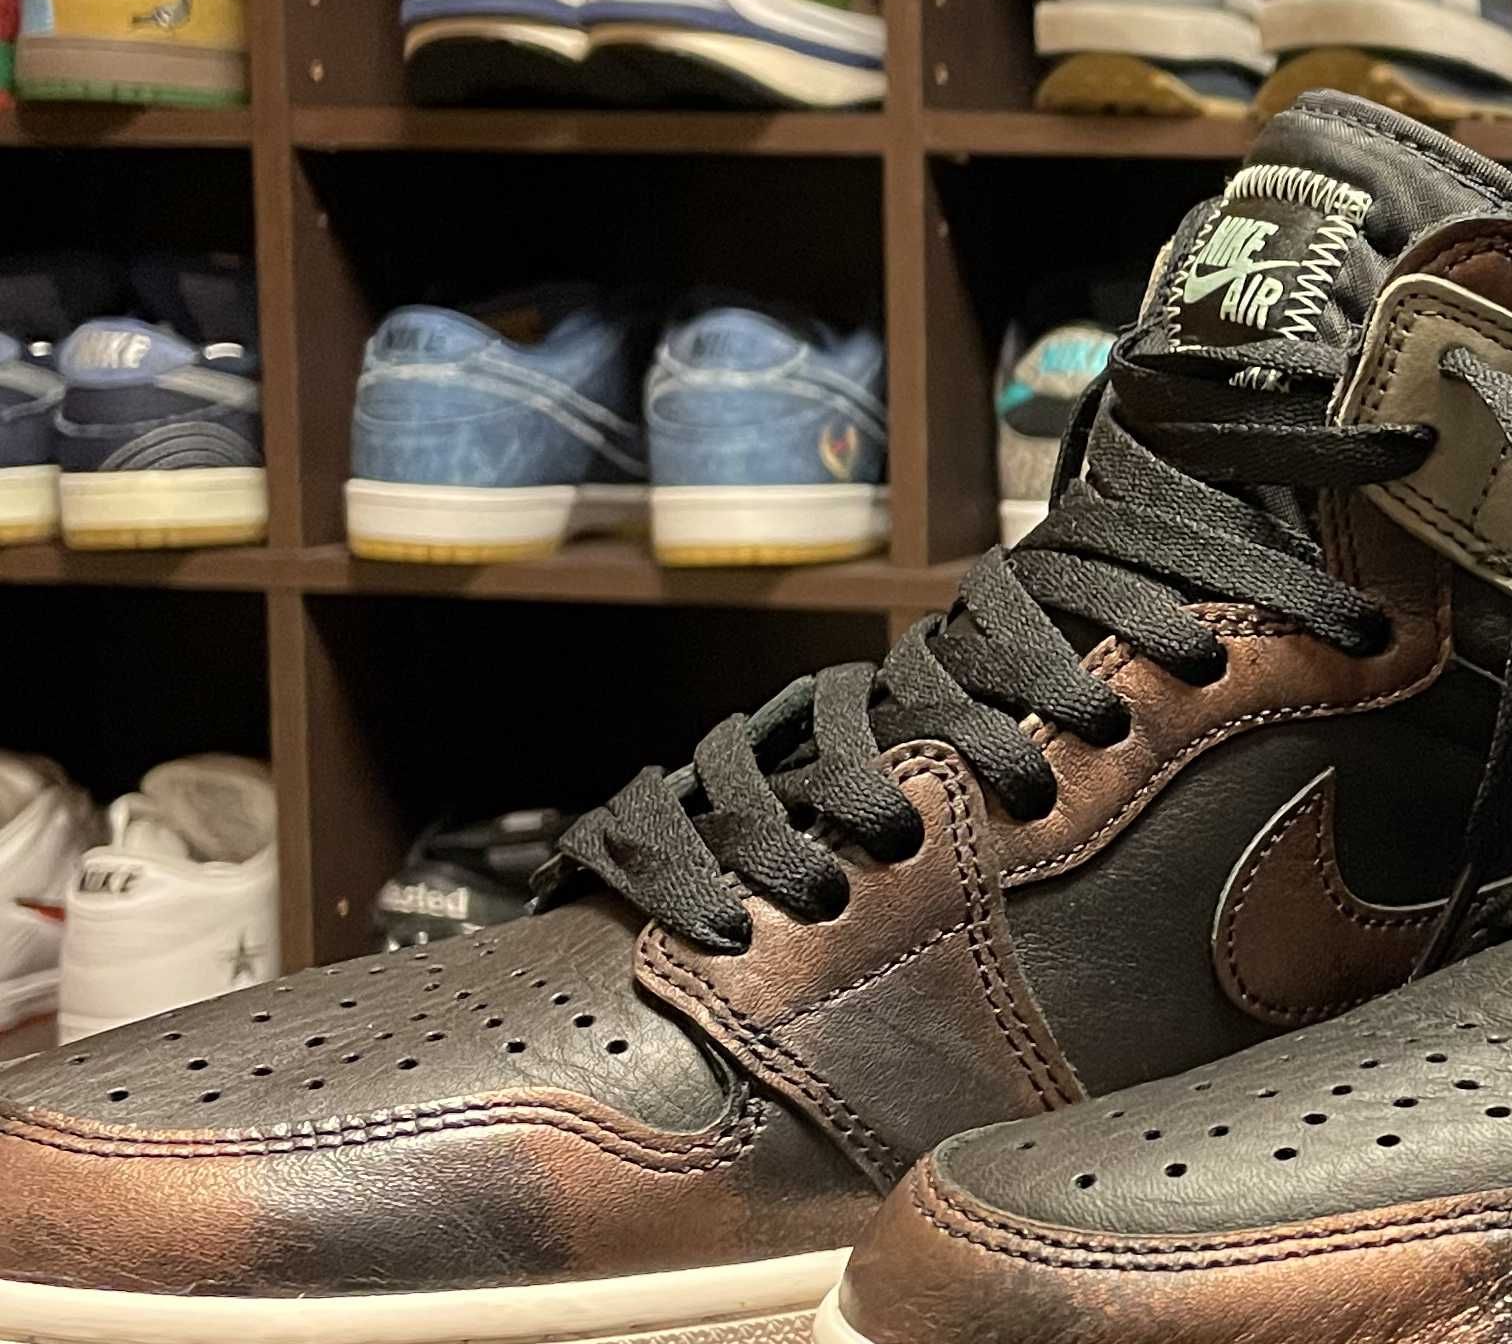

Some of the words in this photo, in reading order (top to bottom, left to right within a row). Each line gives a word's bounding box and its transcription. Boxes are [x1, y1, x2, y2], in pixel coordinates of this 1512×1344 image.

[1202, 215, 1280, 268] NIKE
[1220, 272, 1284, 331] AIR
[76, 330, 151, 369] NIKE
